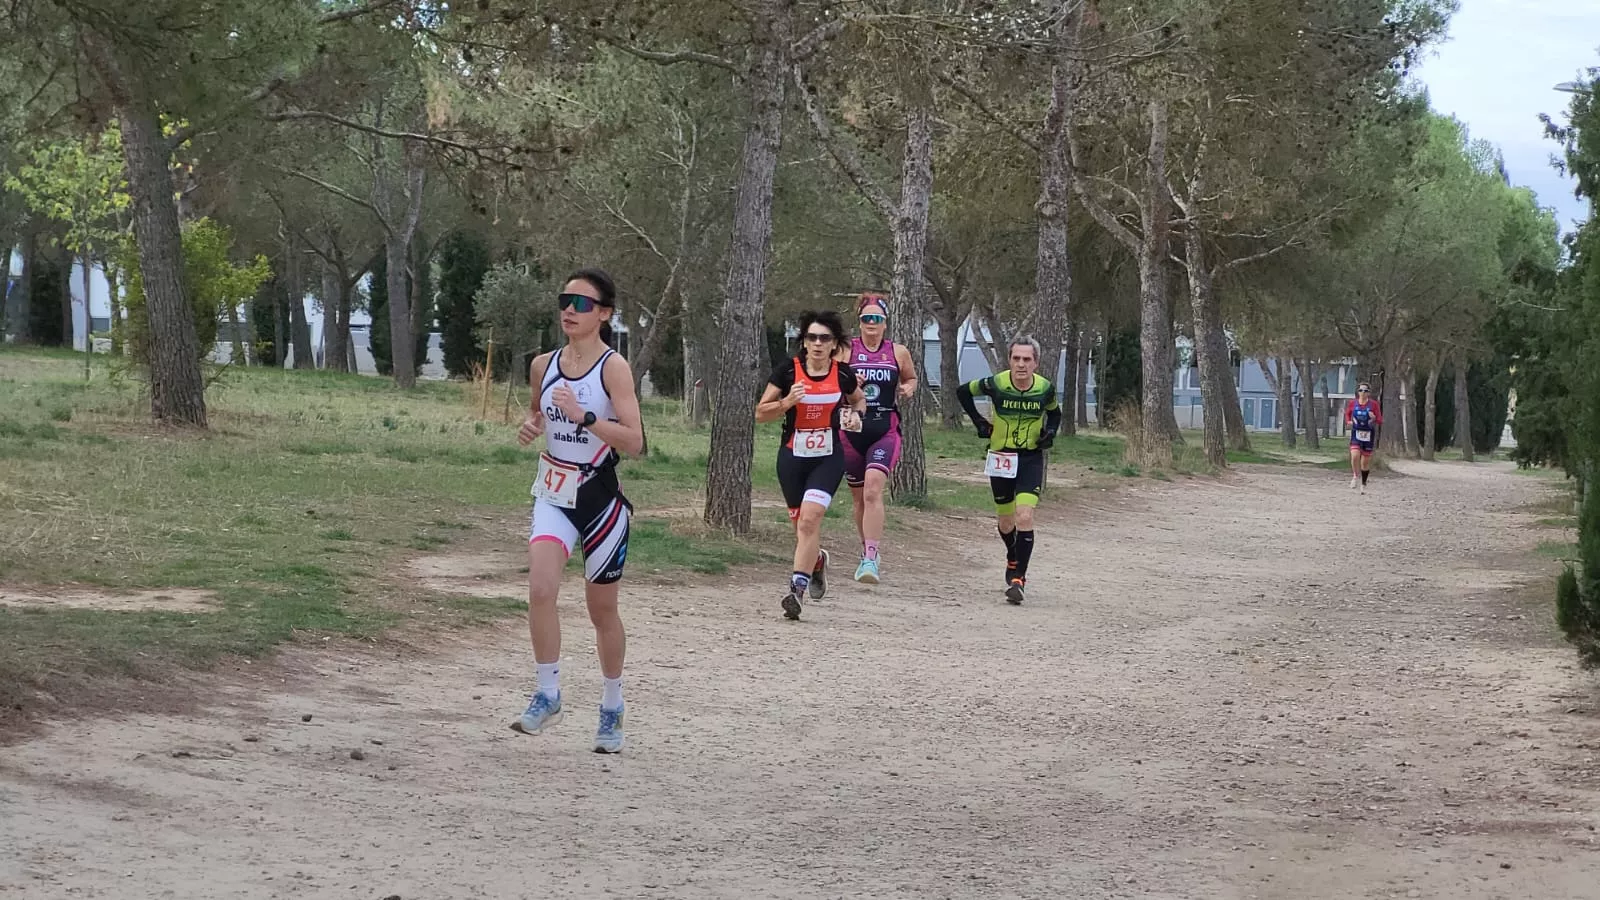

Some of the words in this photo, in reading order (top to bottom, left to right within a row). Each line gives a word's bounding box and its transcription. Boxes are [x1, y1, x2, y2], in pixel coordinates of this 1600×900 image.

[553, 432, 589, 444] alabike
[805, 434, 826, 449] 62
[994, 457, 1012, 471] 14
[544, 469, 567, 493] 47
